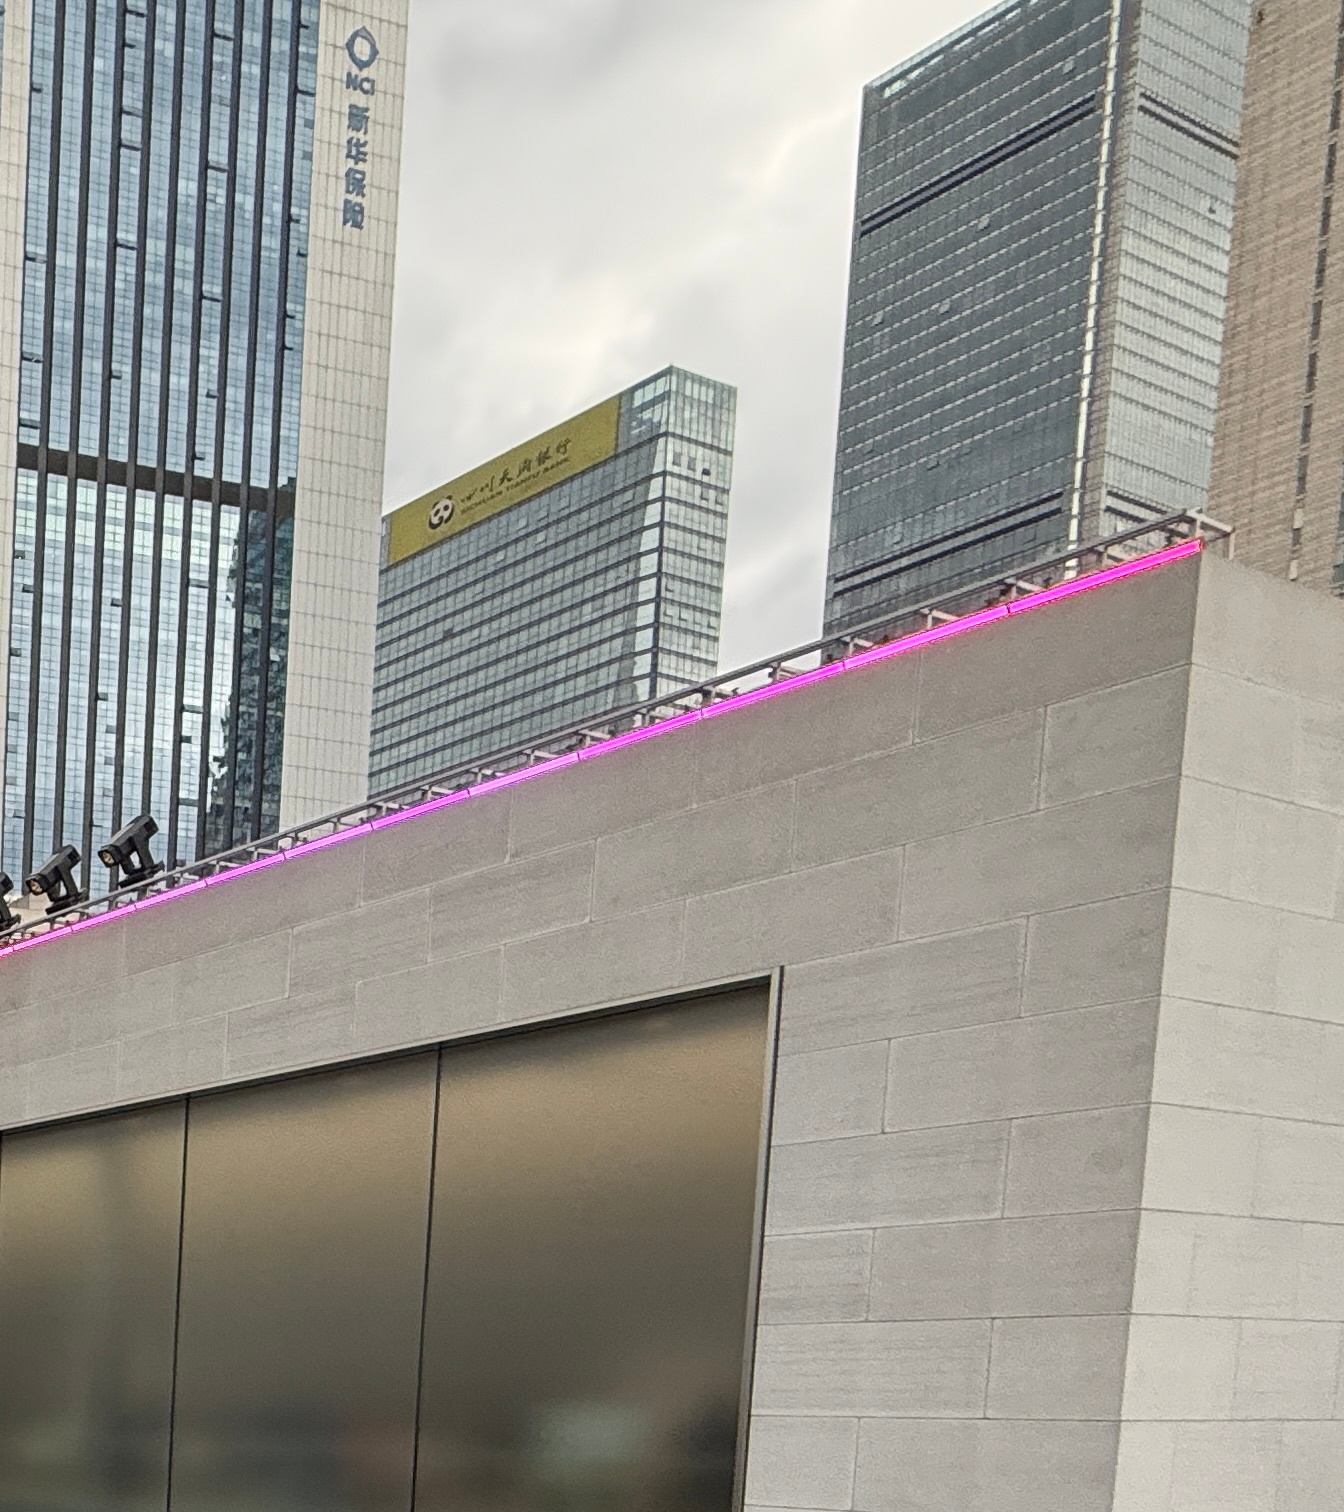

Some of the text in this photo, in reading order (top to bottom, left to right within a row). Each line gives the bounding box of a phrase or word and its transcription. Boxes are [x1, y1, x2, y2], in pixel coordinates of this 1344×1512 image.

[346, 72, 375, 96] NCI
[342, 104, 370, 230] 新华保险
